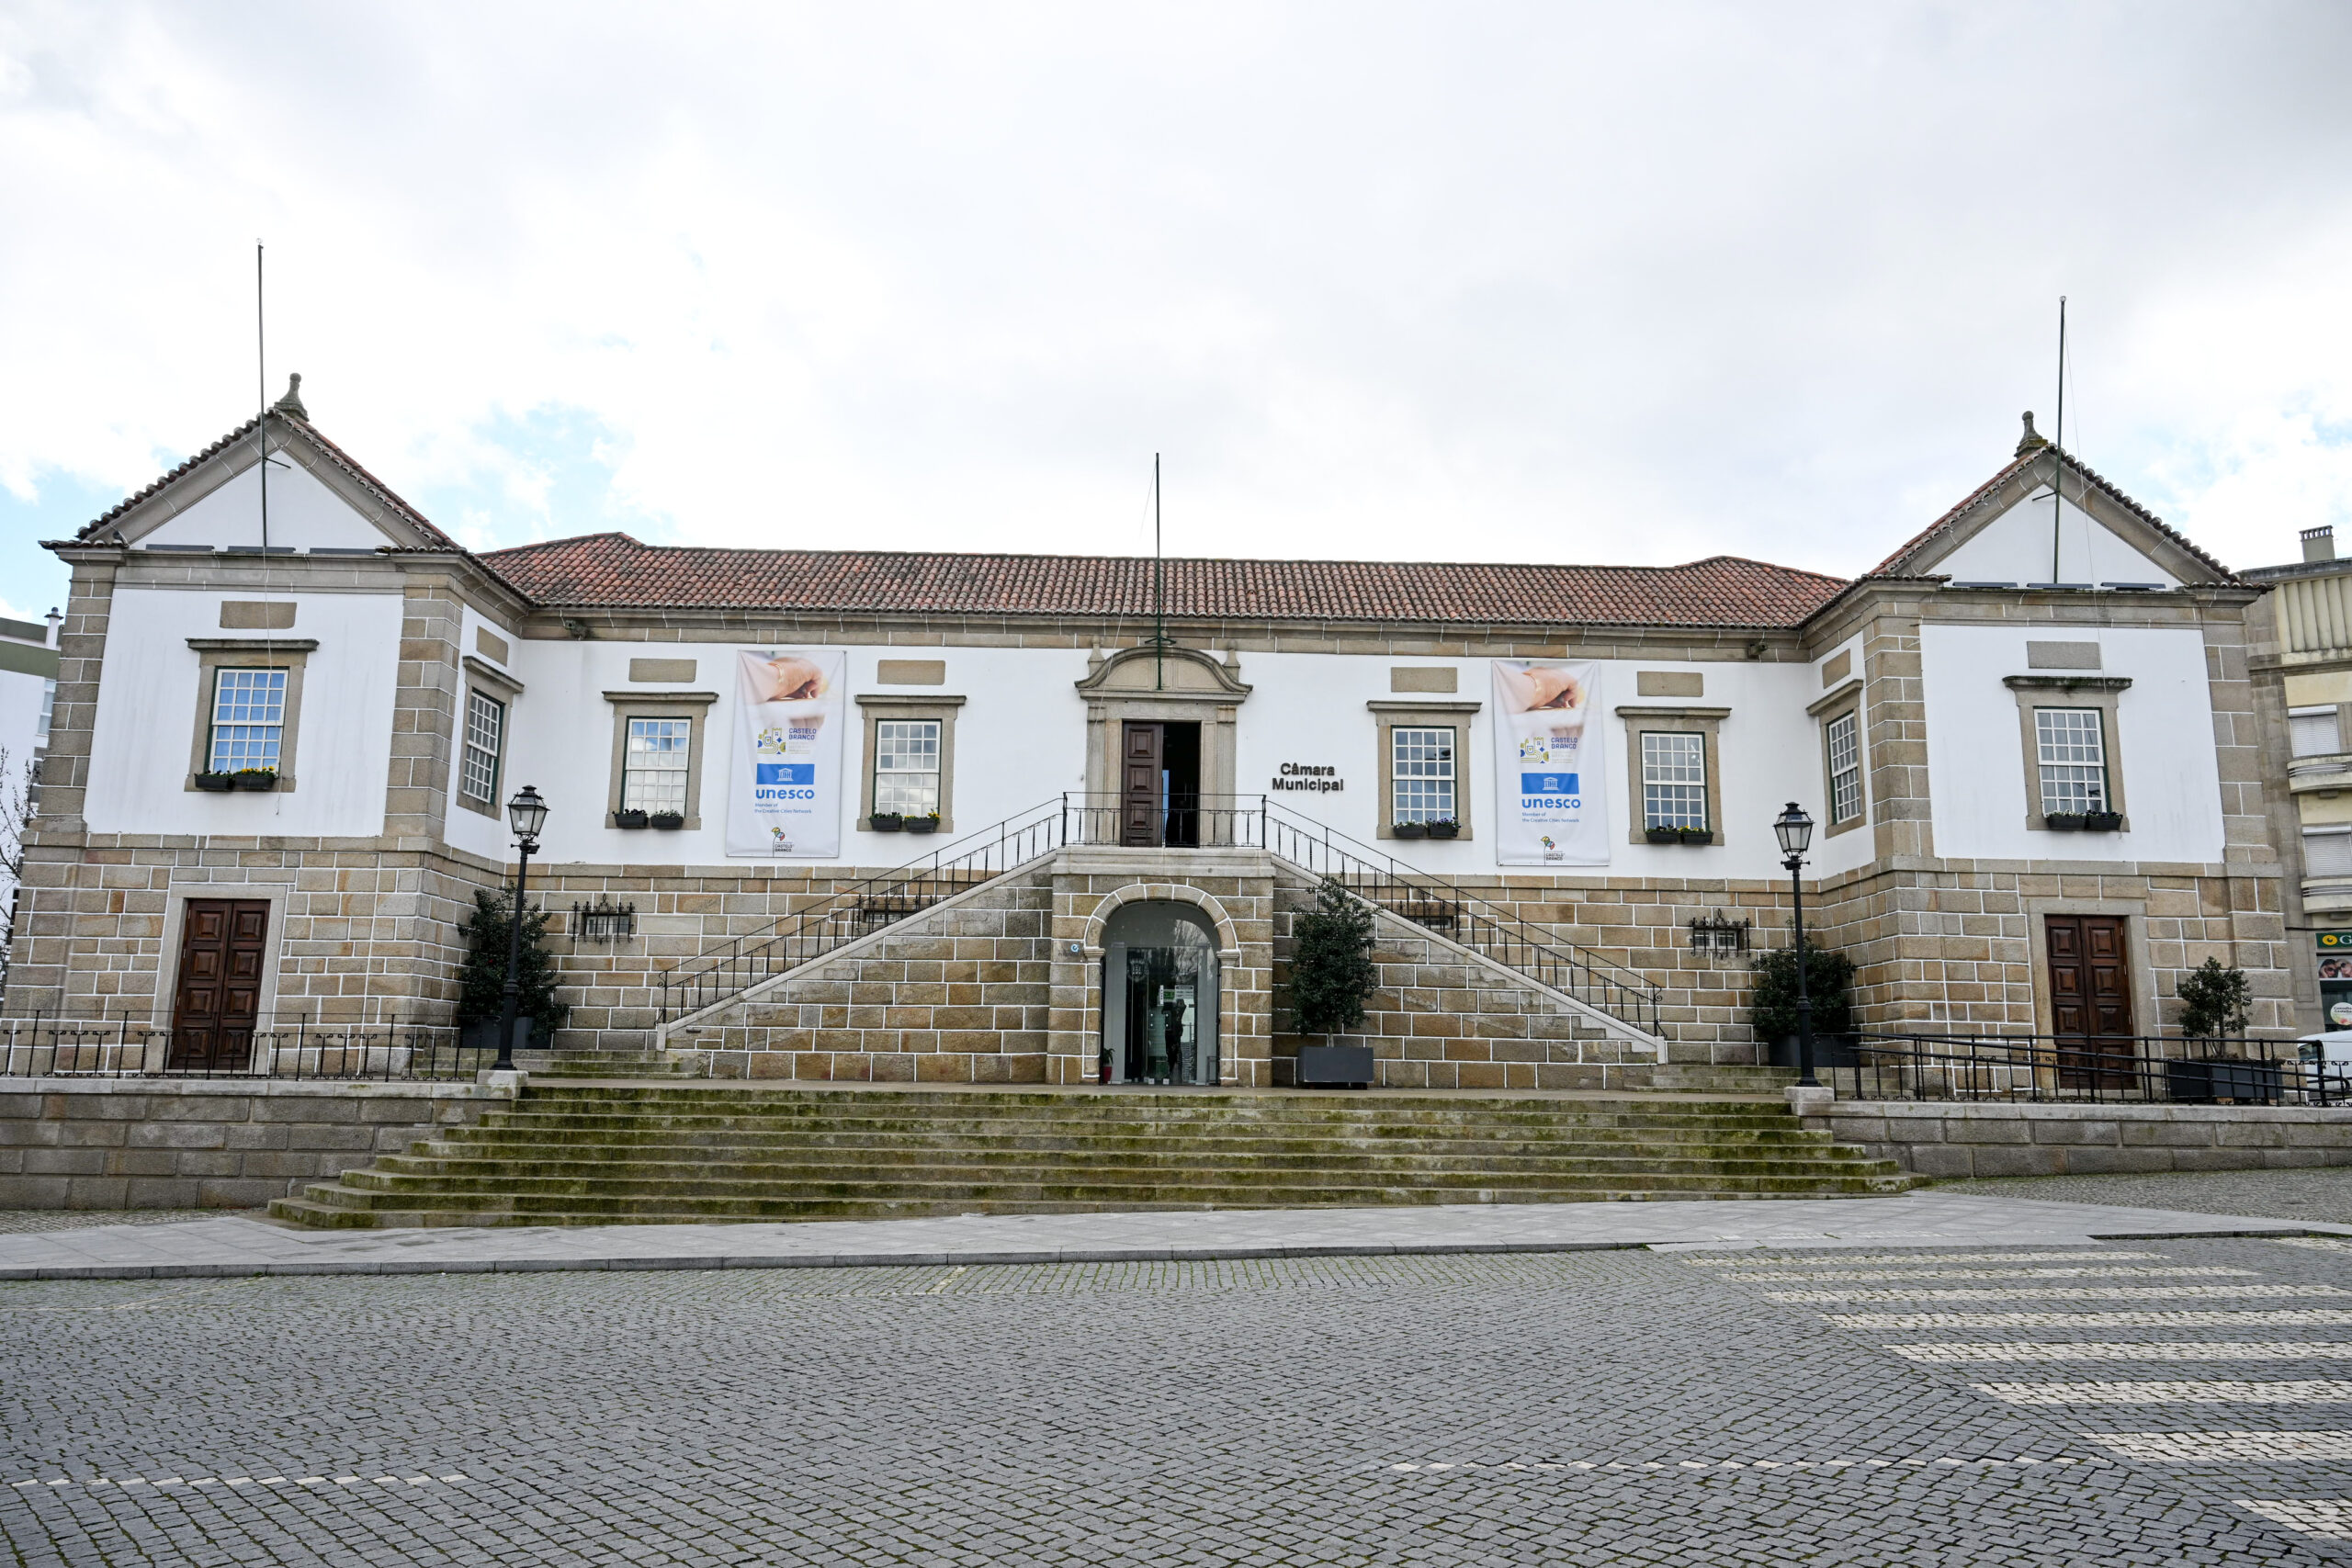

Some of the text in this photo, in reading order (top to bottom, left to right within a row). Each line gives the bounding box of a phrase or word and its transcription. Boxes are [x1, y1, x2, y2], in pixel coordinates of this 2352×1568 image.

[1280, 762, 1335, 776] Câmara
[1272, 778, 1344, 794] Municipal
[755, 789, 815, 799] unesco
[1521, 798, 1581, 808] unesco
